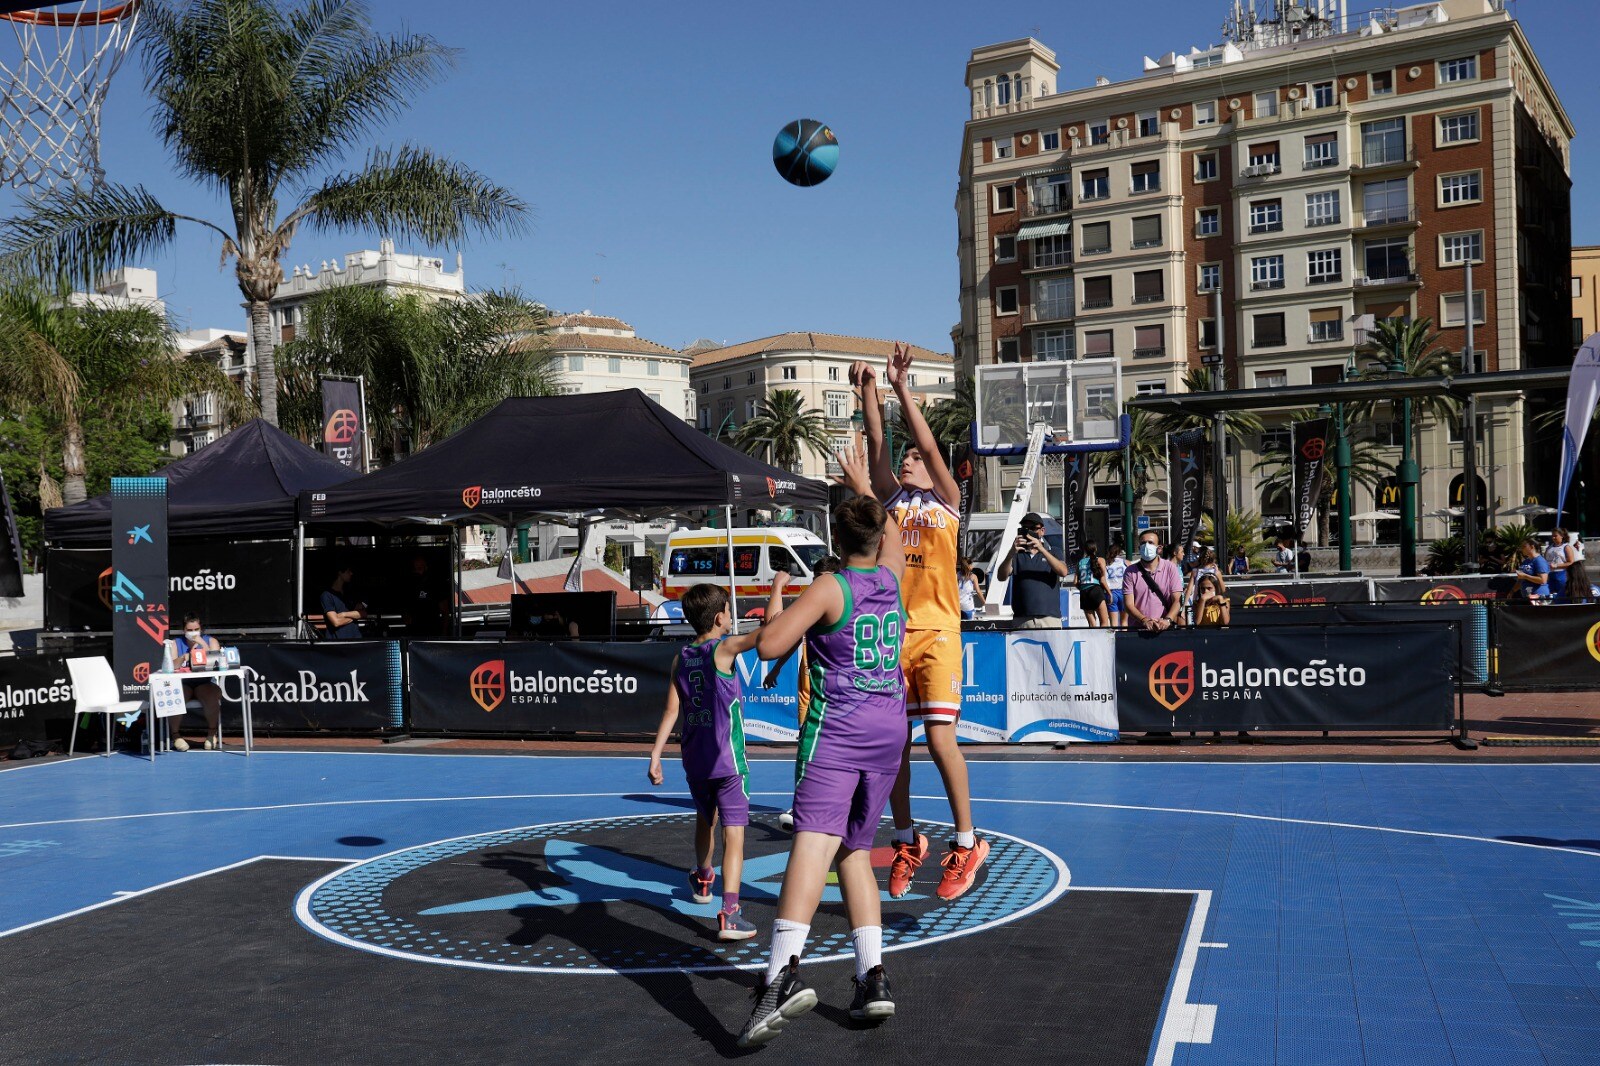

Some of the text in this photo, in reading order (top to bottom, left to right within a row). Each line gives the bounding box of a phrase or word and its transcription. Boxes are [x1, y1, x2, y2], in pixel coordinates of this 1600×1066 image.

[312, 493, 327, 501] FEB
[1068, 479, 1080, 555] CaixaBank
[1180, 476, 1198, 545] CaixaBan
[902, 508, 946, 529] PALO
[693, 560, 713, 569] TSS
[904, 553, 923, 564] YM
[169, 569, 236, 592] ncesto
[115, 604, 166, 613] PLAZA
[853, 610, 901, 672] 89
[195, 651, 203, 663] 9
[221, 665, 370, 703] CaixaBank
[688, 669, 705, 708] 3
[511, 694, 558, 704] ESPAÑA
[749, 694, 759, 702] de
[761, 694, 796, 705] málaga
[966, 691, 1004, 704] málaga
[1011, 691, 1115, 705] diputación de málaga
[1202, 688, 1262, 700] ESPAÑA
[1049, 720, 1081, 729] diputación
[1089, 726, 1114, 738] deporte
